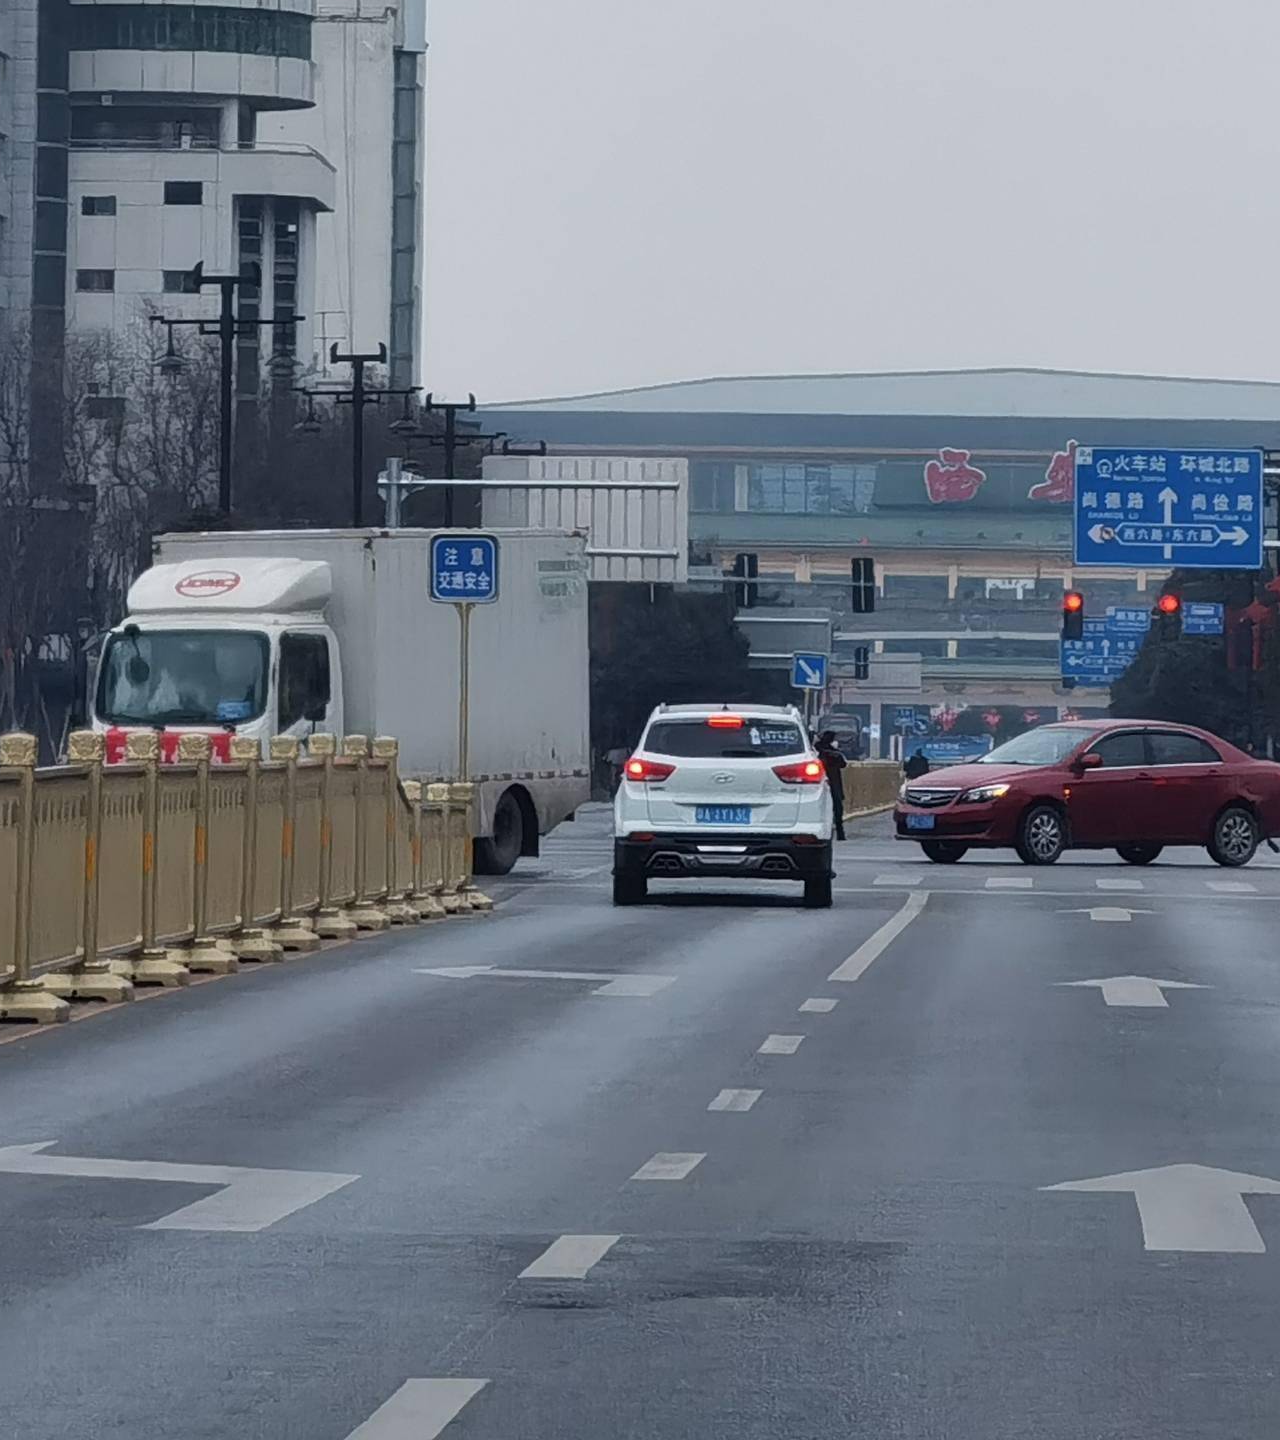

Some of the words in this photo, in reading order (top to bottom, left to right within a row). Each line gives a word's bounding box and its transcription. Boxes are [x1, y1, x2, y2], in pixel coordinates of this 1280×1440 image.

[1115, 455, 1166, 471] 火车站
[1180, 456, 1250, 472] 环城北路
[438, 571, 490, 590] 交通安全
